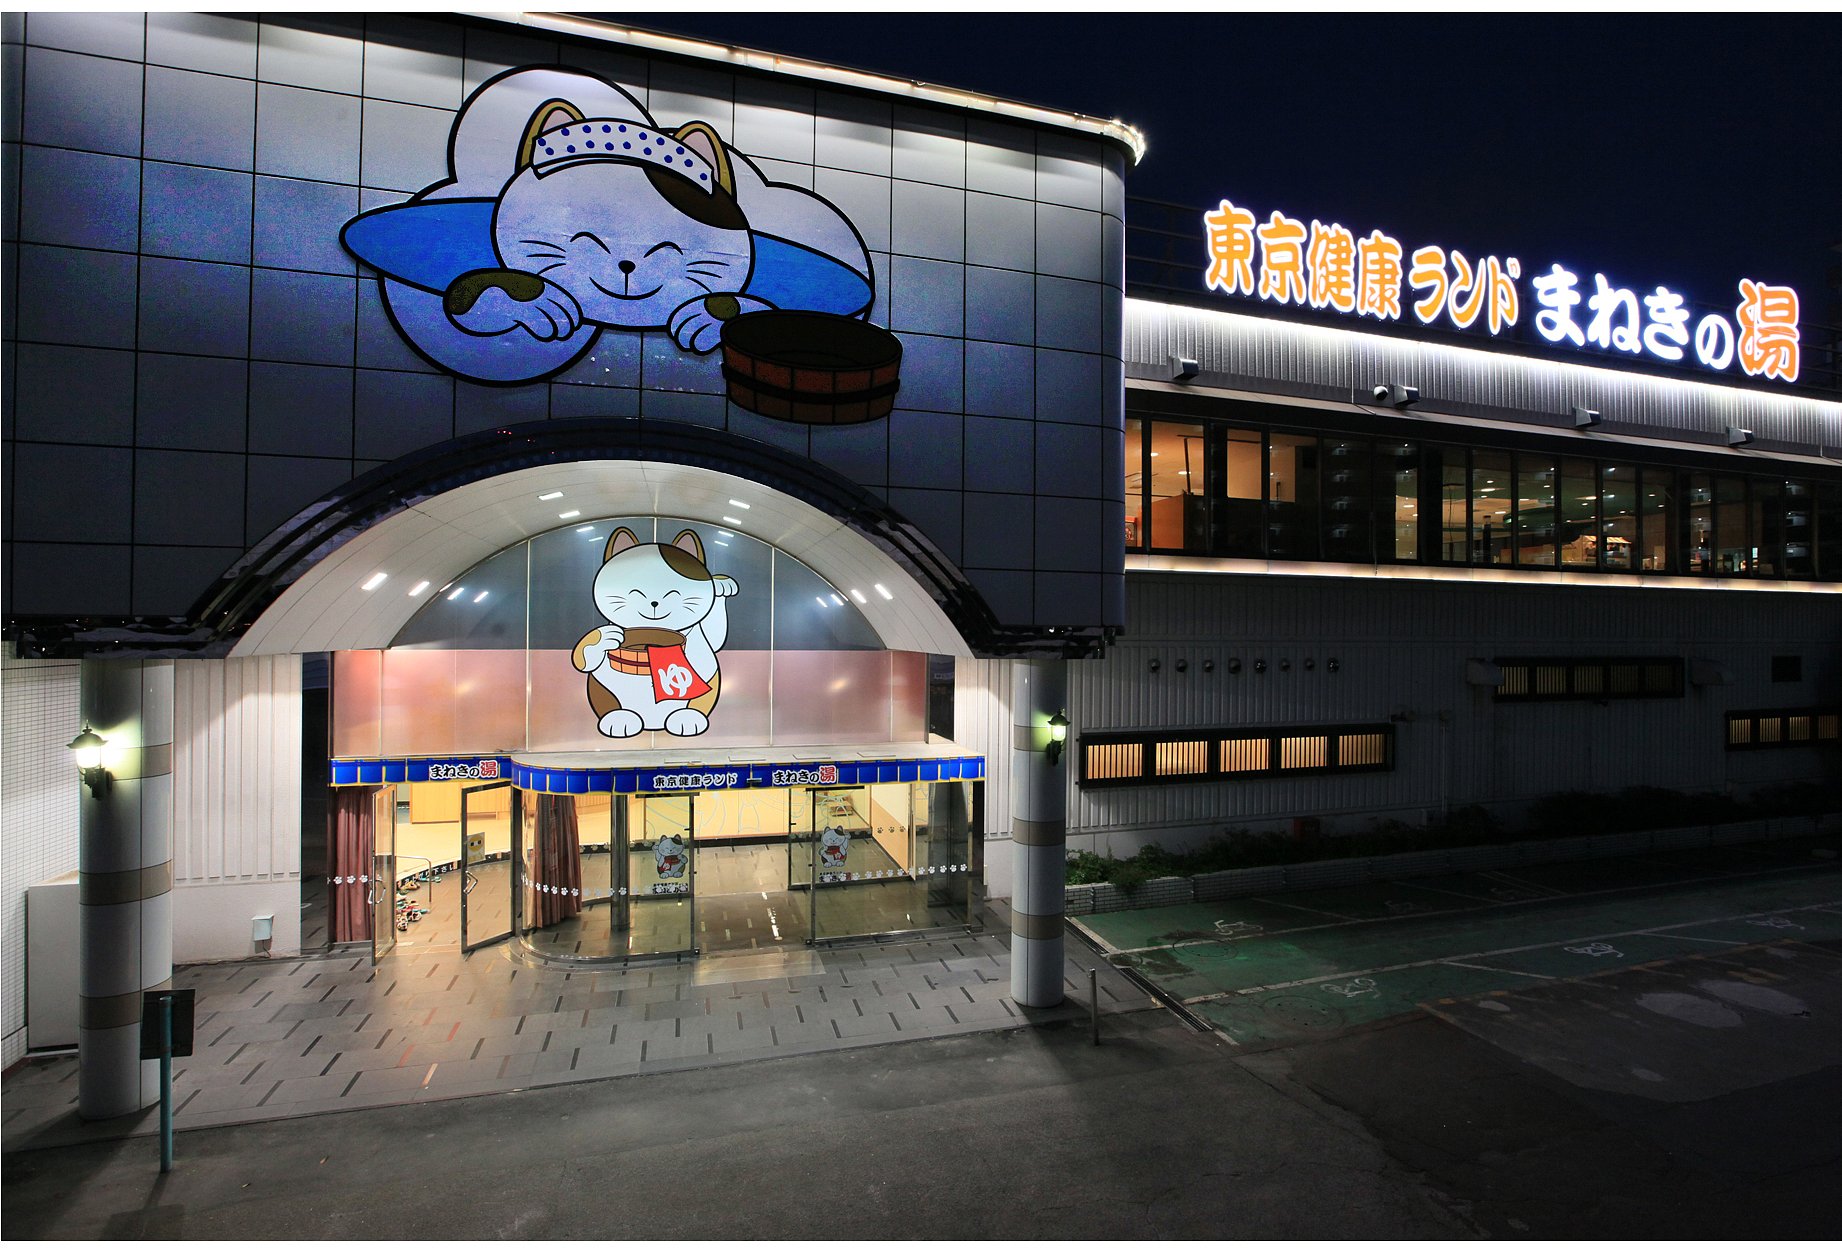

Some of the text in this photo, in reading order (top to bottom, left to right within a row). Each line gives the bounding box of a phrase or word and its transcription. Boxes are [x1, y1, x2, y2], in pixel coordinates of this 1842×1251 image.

[1204, 199, 1799, 382] 東京健康ランド まねきの湯
[657, 663, 693, 697] ゆ
[430, 760, 498, 779] まねきの湯
[654, 765, 836, 788] 東京健康ランド まねきの湯
